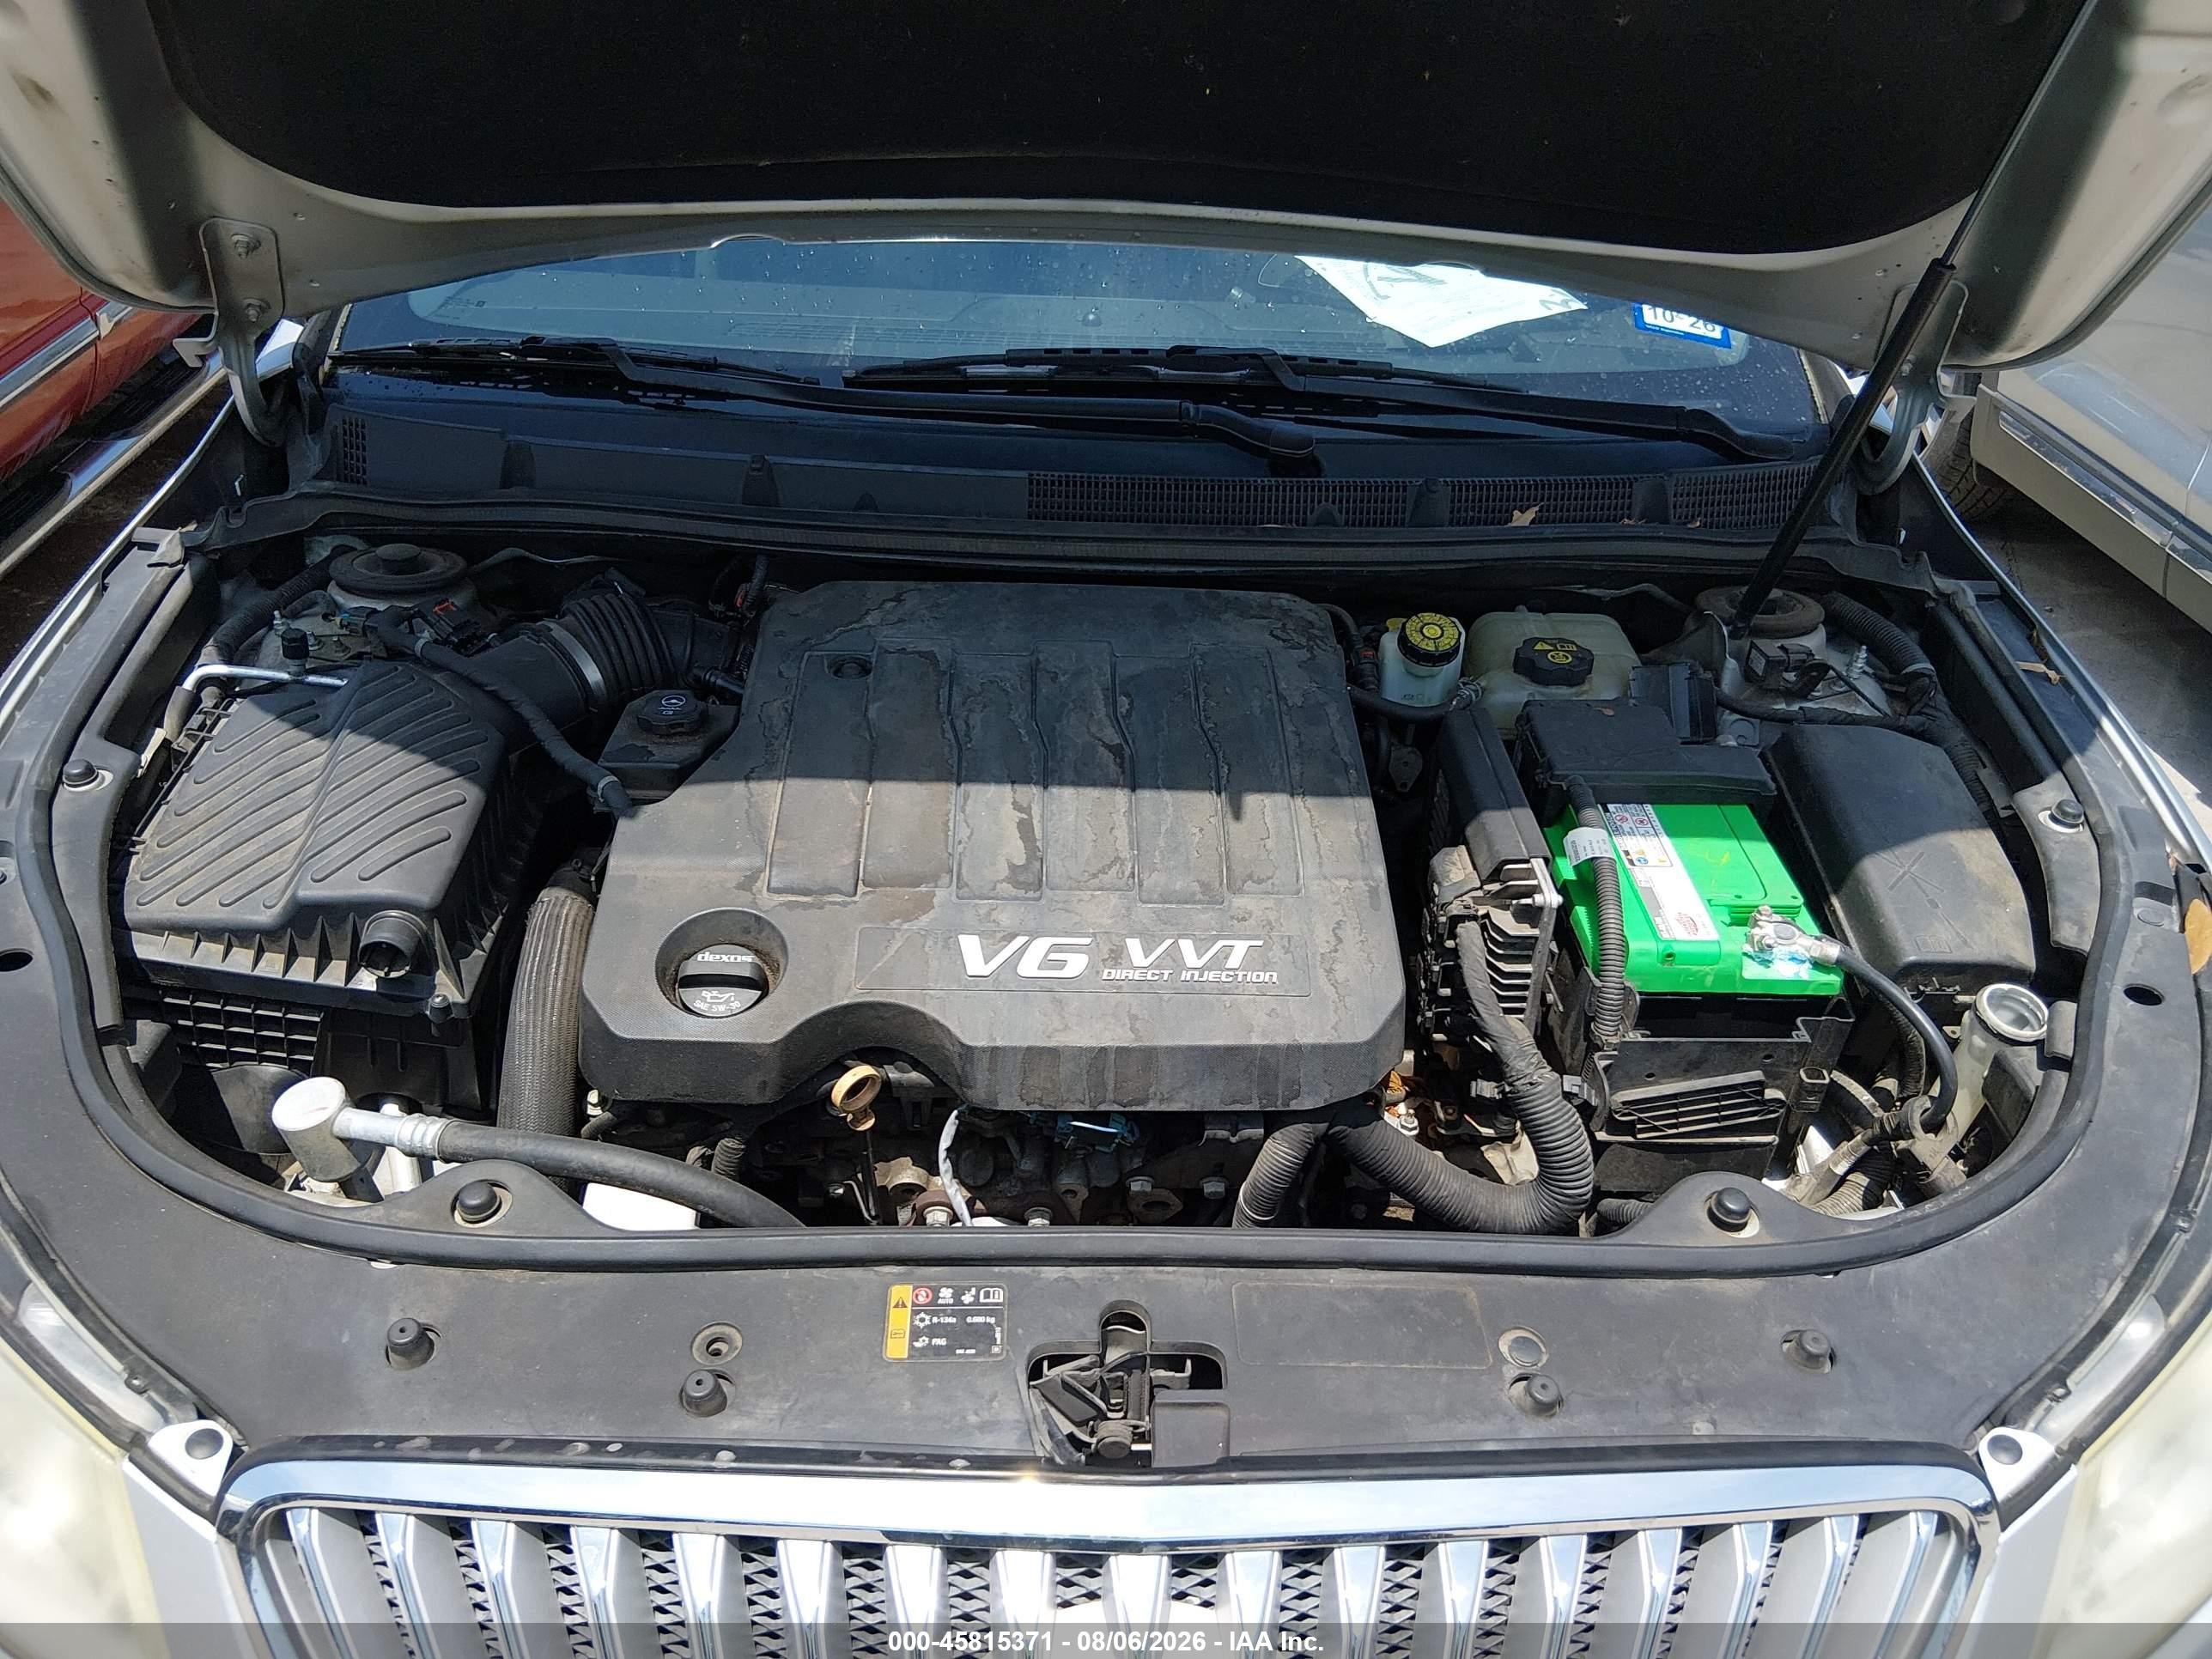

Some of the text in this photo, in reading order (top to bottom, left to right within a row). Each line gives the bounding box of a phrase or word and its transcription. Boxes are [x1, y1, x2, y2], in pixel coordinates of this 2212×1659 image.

[696, 951, 756, 962] dexos
[957, 934, 1264, 979] V6 VVT
[1102, 969, 1279, 983] DIRECT INJECTION
[693, 1000, 741, 1012] SAE 5W-30
[932, 1316, 957, 1324] R-134a
[986, 1316, 996, 1325] kg
[931, 1337, 947, 1346] PAG
